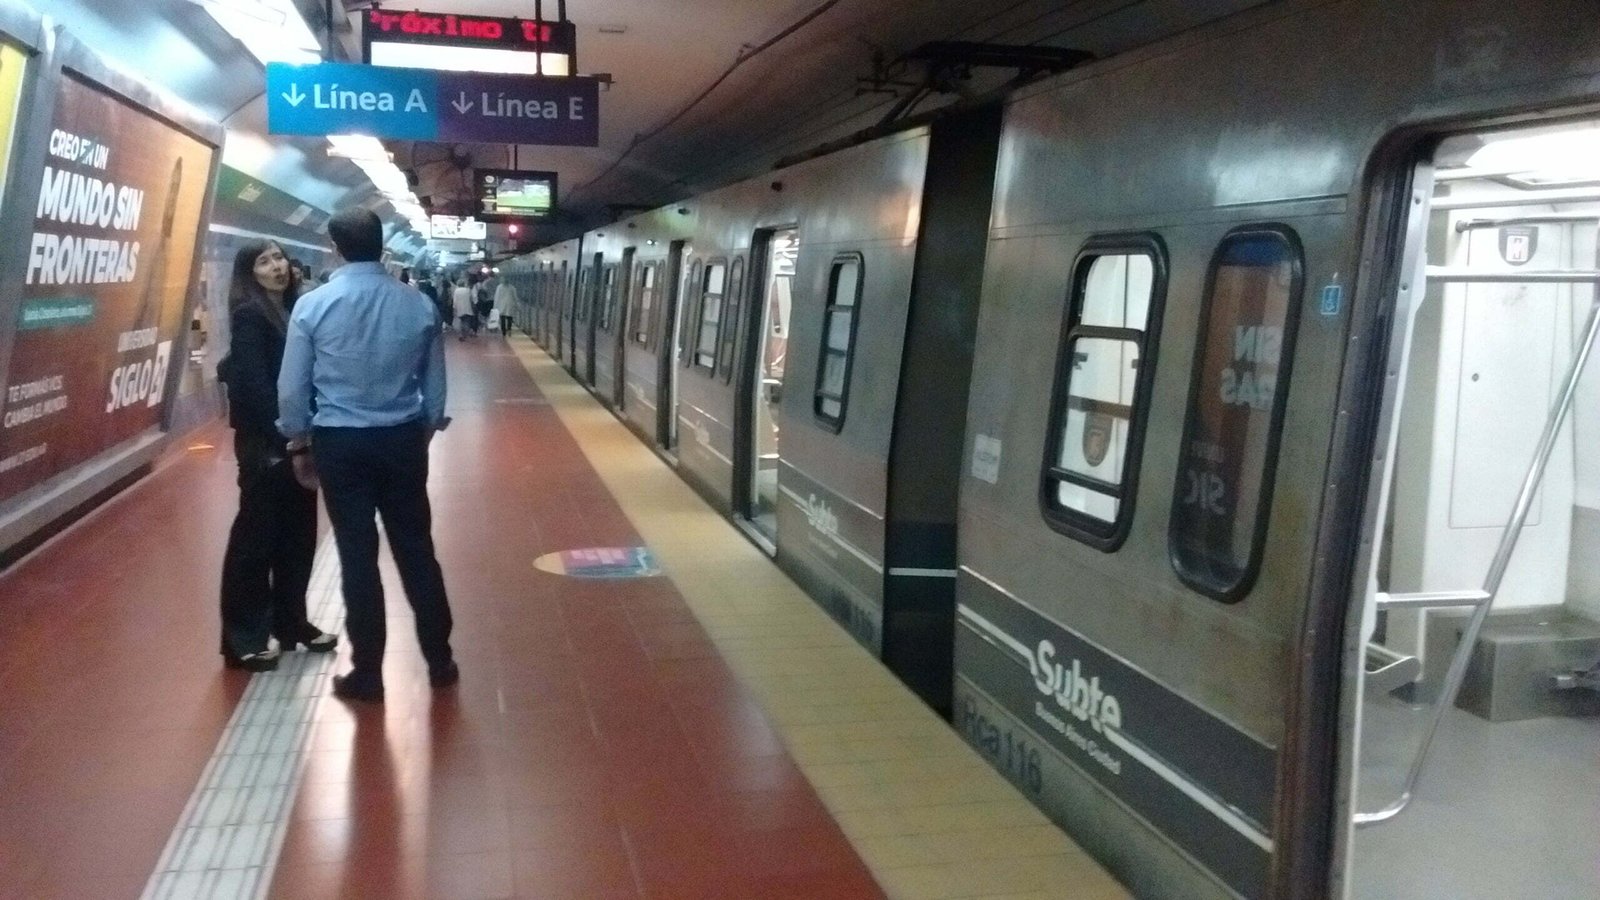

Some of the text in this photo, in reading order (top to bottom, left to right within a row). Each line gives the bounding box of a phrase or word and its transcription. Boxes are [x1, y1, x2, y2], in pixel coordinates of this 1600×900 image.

[313, 82, 428, 114] Línea A
[481, 91, 584, 120] Línea E
[50, 128, 80, 162] CREO
[93, 143, 109, 170] UN
[36, 166, 144, 231] MUNDO SIN
[26, 232, 140, 286] FRONTERAS
[106, 358, 153, 414] SIGLO
[1035, 639, 1122, 734] Subte
